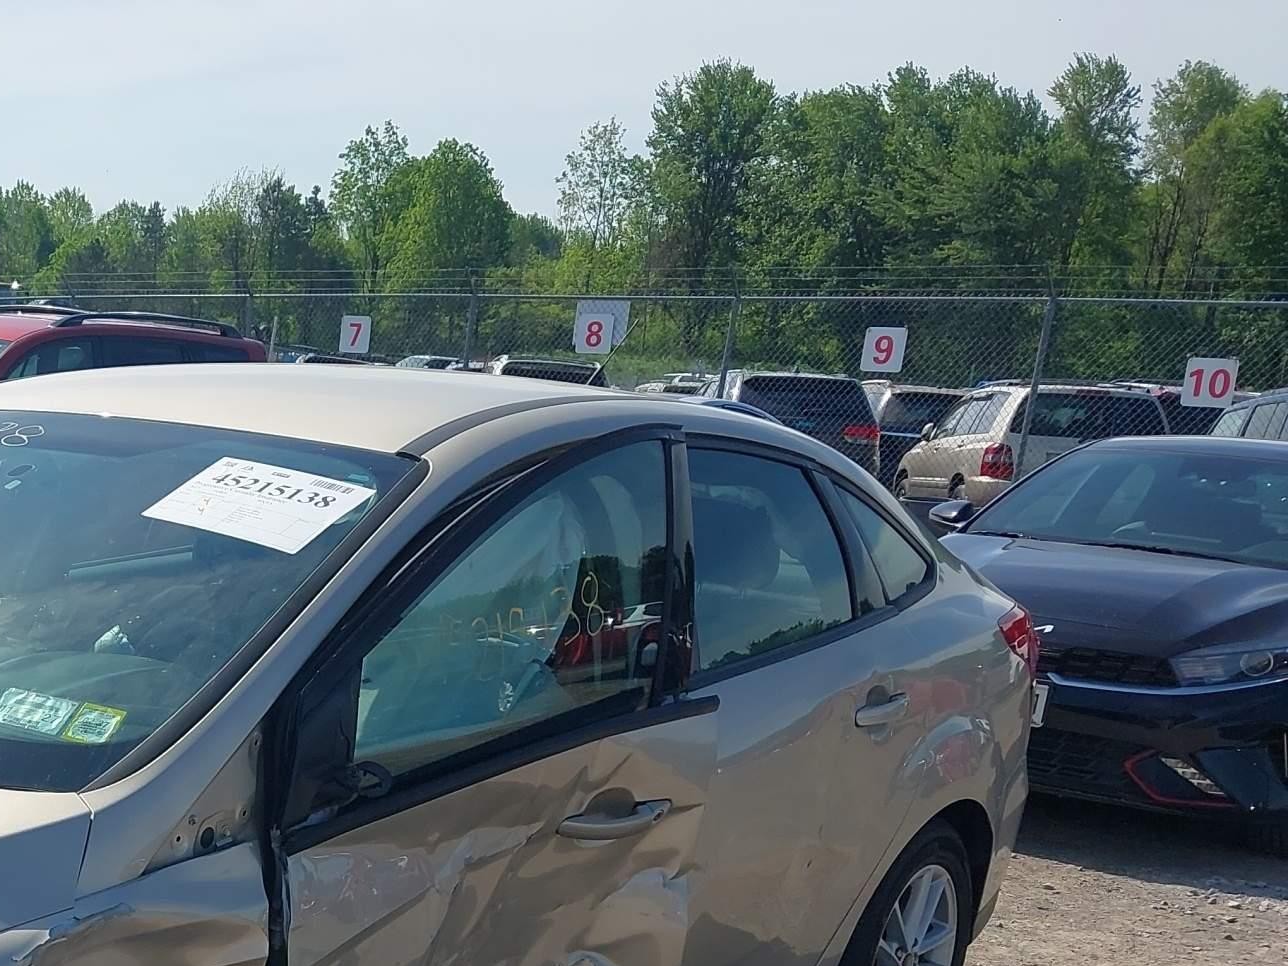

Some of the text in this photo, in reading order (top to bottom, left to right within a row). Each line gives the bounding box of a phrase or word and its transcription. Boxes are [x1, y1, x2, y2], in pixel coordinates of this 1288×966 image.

[349, 323, 363, 347] 7
[585, 321, 604, 347] 8
[872, 335, 894, 365] 9
[1188, 368, 1232, 399] 10
[212, 472, 337, 509] 45215138
